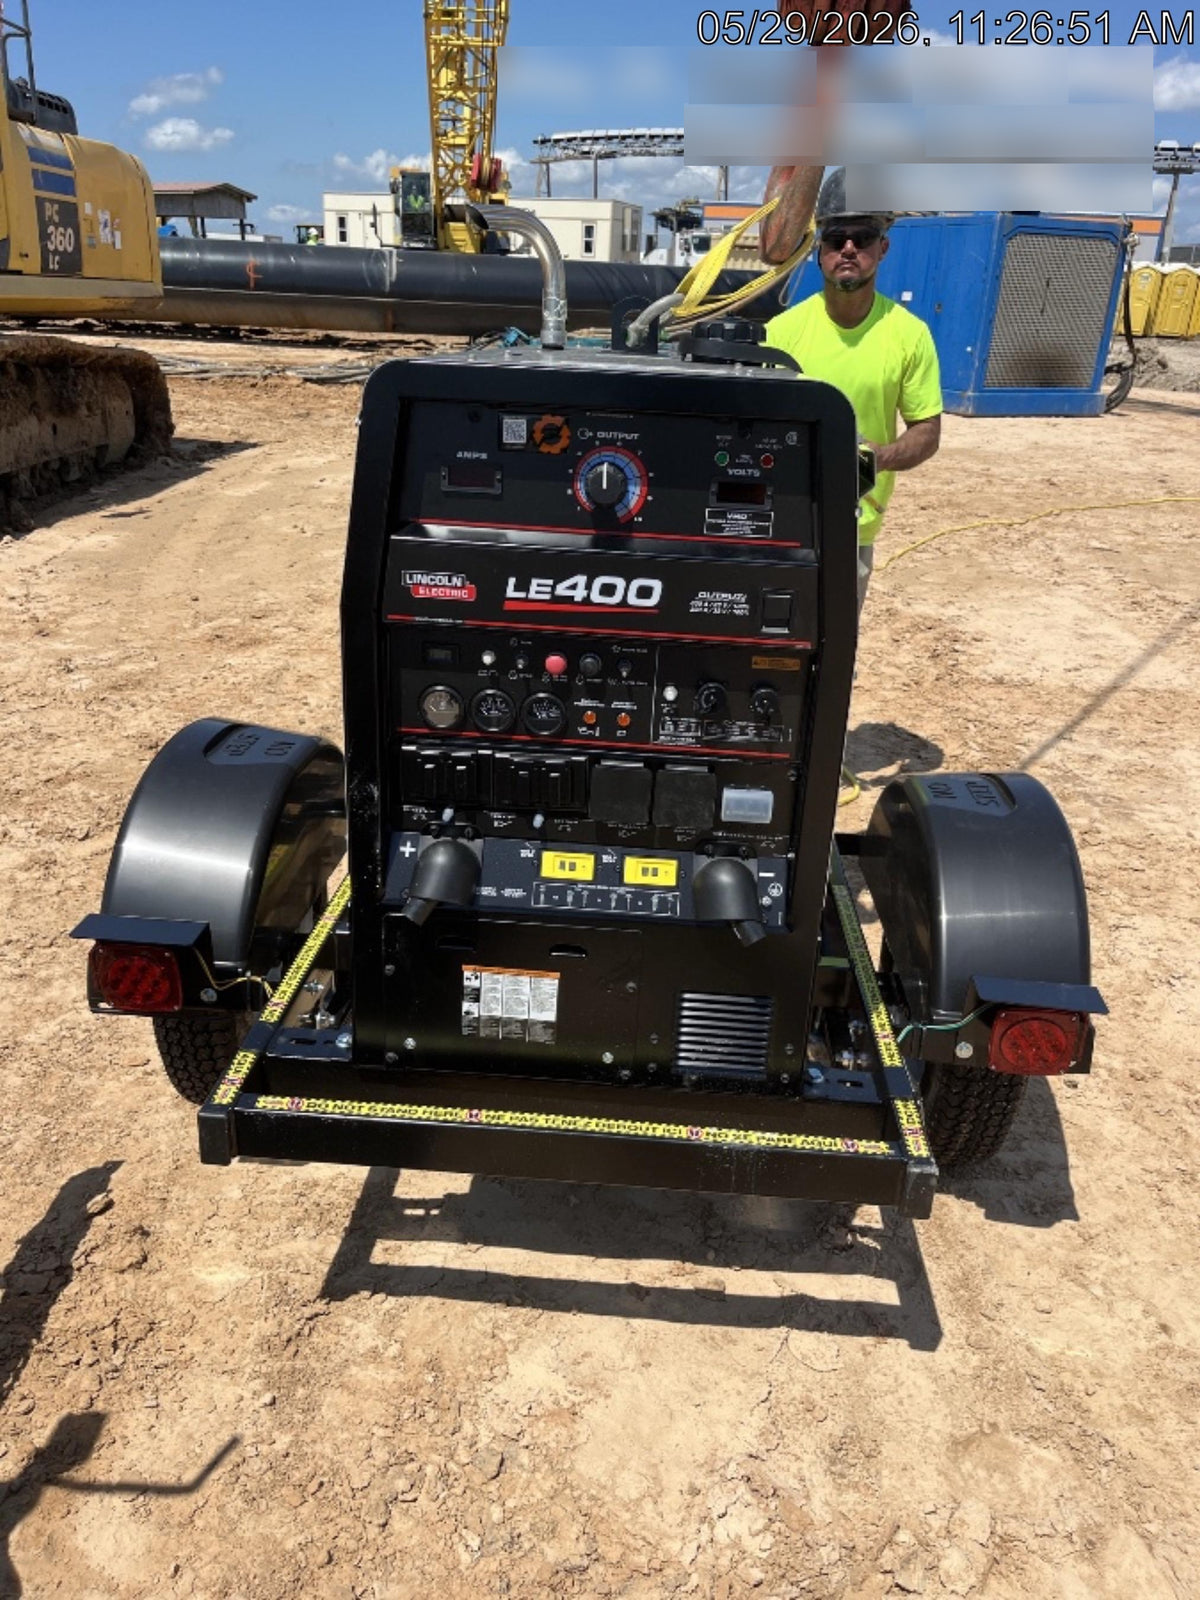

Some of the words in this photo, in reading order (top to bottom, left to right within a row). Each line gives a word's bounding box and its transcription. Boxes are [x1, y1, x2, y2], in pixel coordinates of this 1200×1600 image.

[44, 202, 59, 223] PC
[47, 225, 75, 253] 360
[49, 252, 60, 270] LC
[597, 431, 640, 440] OUTPUT
[727, 469, 760, 477] VOLTS
[405, 573, 463, 587] LINCOLN
[418, 586, 469, 599] ELECTRIC
[505, 574, 663, 607] LE400
[306, 1102, 330, 1110] DO
[333, 1102, 363, 1112] NOT
[368, 1104, 418, 1116] STAND
[422, 1108, 463, 1118] HERE
